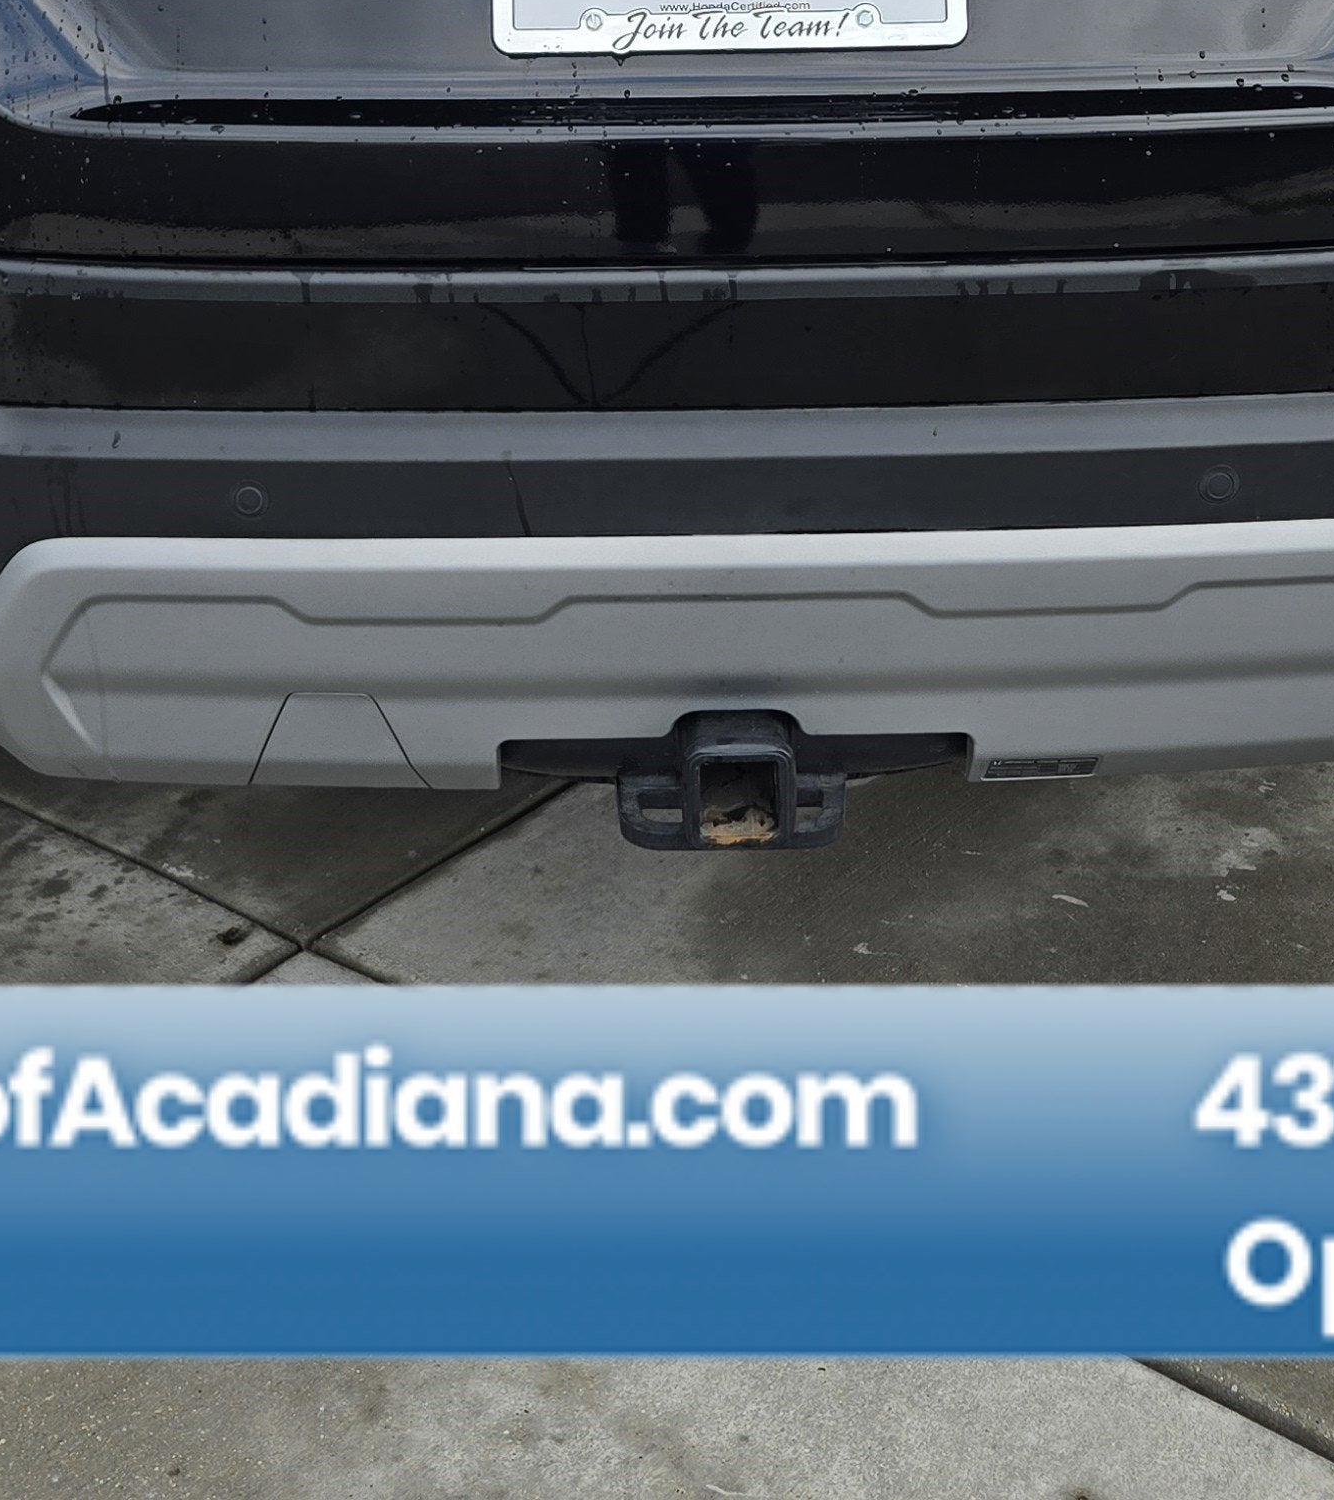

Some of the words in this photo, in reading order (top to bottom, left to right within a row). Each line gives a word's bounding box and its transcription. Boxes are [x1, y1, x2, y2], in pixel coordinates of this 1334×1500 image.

[612, 11, 688, 51] Join
[692, 10, 749, 41] The
[752, 8, 850, 40] Team!
